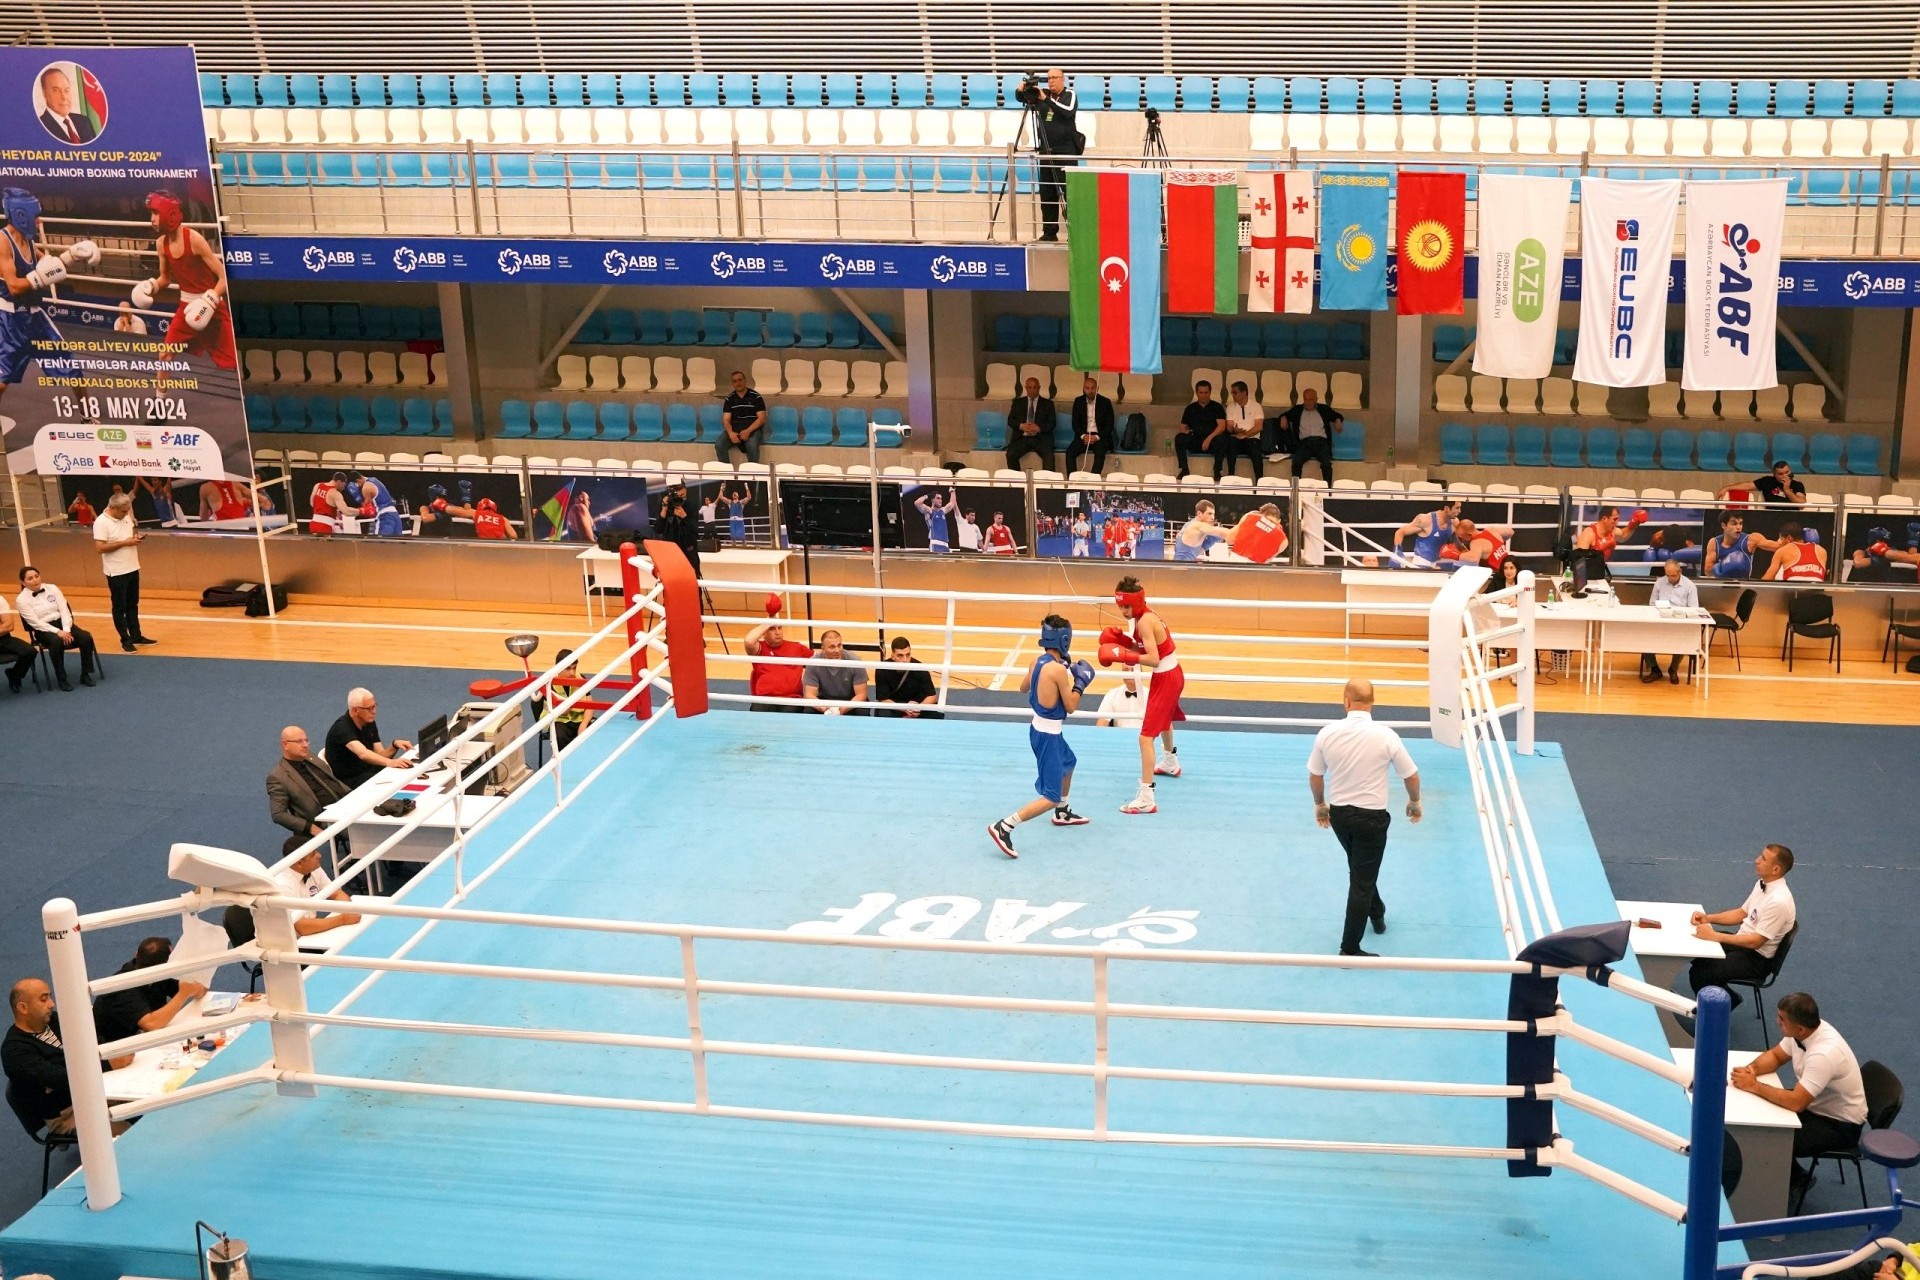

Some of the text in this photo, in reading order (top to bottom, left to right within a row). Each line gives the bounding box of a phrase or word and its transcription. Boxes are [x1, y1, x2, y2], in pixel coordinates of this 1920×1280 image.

[54, 151, 97, 162] ALIYEV
[0, 166, 199, 179] ATIONAL JUNIOR BOXING TOURNAMENT
[1706, 223, 1714, 277] AZƏRBAYCAN
[226, 251, 253, 263] ABB
[327, 252, 355, 264] ABB
[418, 253, 446, 265] ABB
[523, 254, 551, 266] ABB
[629, 255, 658, 268] ABB
[736, 257, 766, 270] ABB
[846, 259, 876, 272] ABB
[957, 261, 987, 274] ABB
[1502, 252, 1511, 306] GƏNCLƏR VƏ
[1517, 251, 1540, 307] AZE
[1777, 276, 1795, 290] BB
[1872, 277, 1906, 291] ABB
[1614, 247, 1639, 360] EUBC
[1716, 262, 1753, 357] ABF
[87, 340, 131, 352] ƏLİYEV
[35, 356, 191, 371] YENİYETMƏLƏR ARASINDA
[37, 376, 199, 390] BEYNƏLXALQ BOKS TURNİRİ
[106, 397, 140, 419] MAY
[144, 398, 188, 420] 2024
[57, 431, 95, 440] EUBC
[102, 430, 123, 440] AZE
[173, 433, 200, 446] ABF
[72, 458, 94, 467] ABB
[112, 458, 162, 468] Kapital Bank
[477, 514, 500, 526] AZE
[786, 893, 1088, 944] ABF
